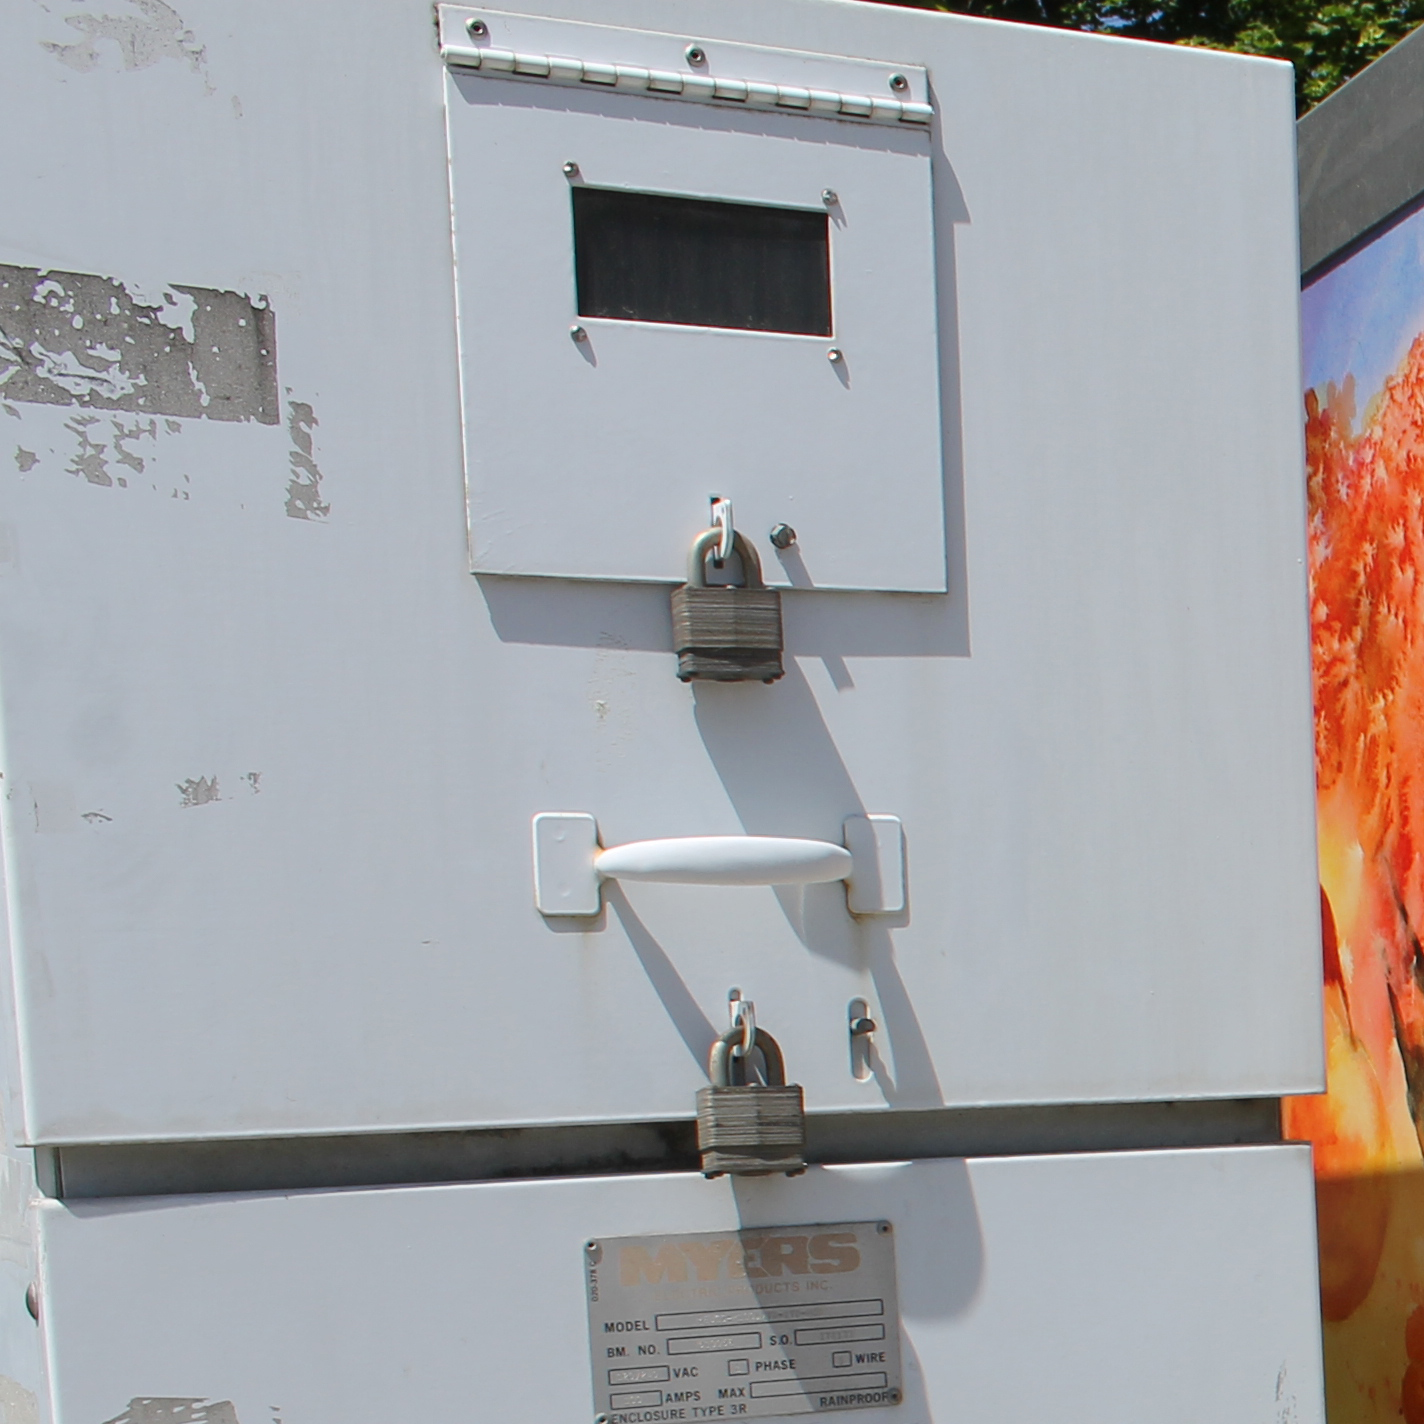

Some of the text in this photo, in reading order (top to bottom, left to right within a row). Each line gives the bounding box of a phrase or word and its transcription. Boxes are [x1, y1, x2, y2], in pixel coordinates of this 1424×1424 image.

[620, 1232, 861, 1287] MYERS
[806, 1280, 832, 1291] INC.
[604, 1320, 650, 1333] MODEL
[607, 1344, 660, 1358] BM. NO.
[673, 1366, 699, 1378] VAC
[755, 1359, 796, 1372] PHASE
[855, 1351, 886, 1363] WIRE
[665, 1390, 701, 1403] AMPS
[718, 1387, 746, 1399] MAX
[820, 1391, 889, 1407] RAINPROOF
[611, 1403, 747, 1424] ENCLOSURE TYPE 3R
